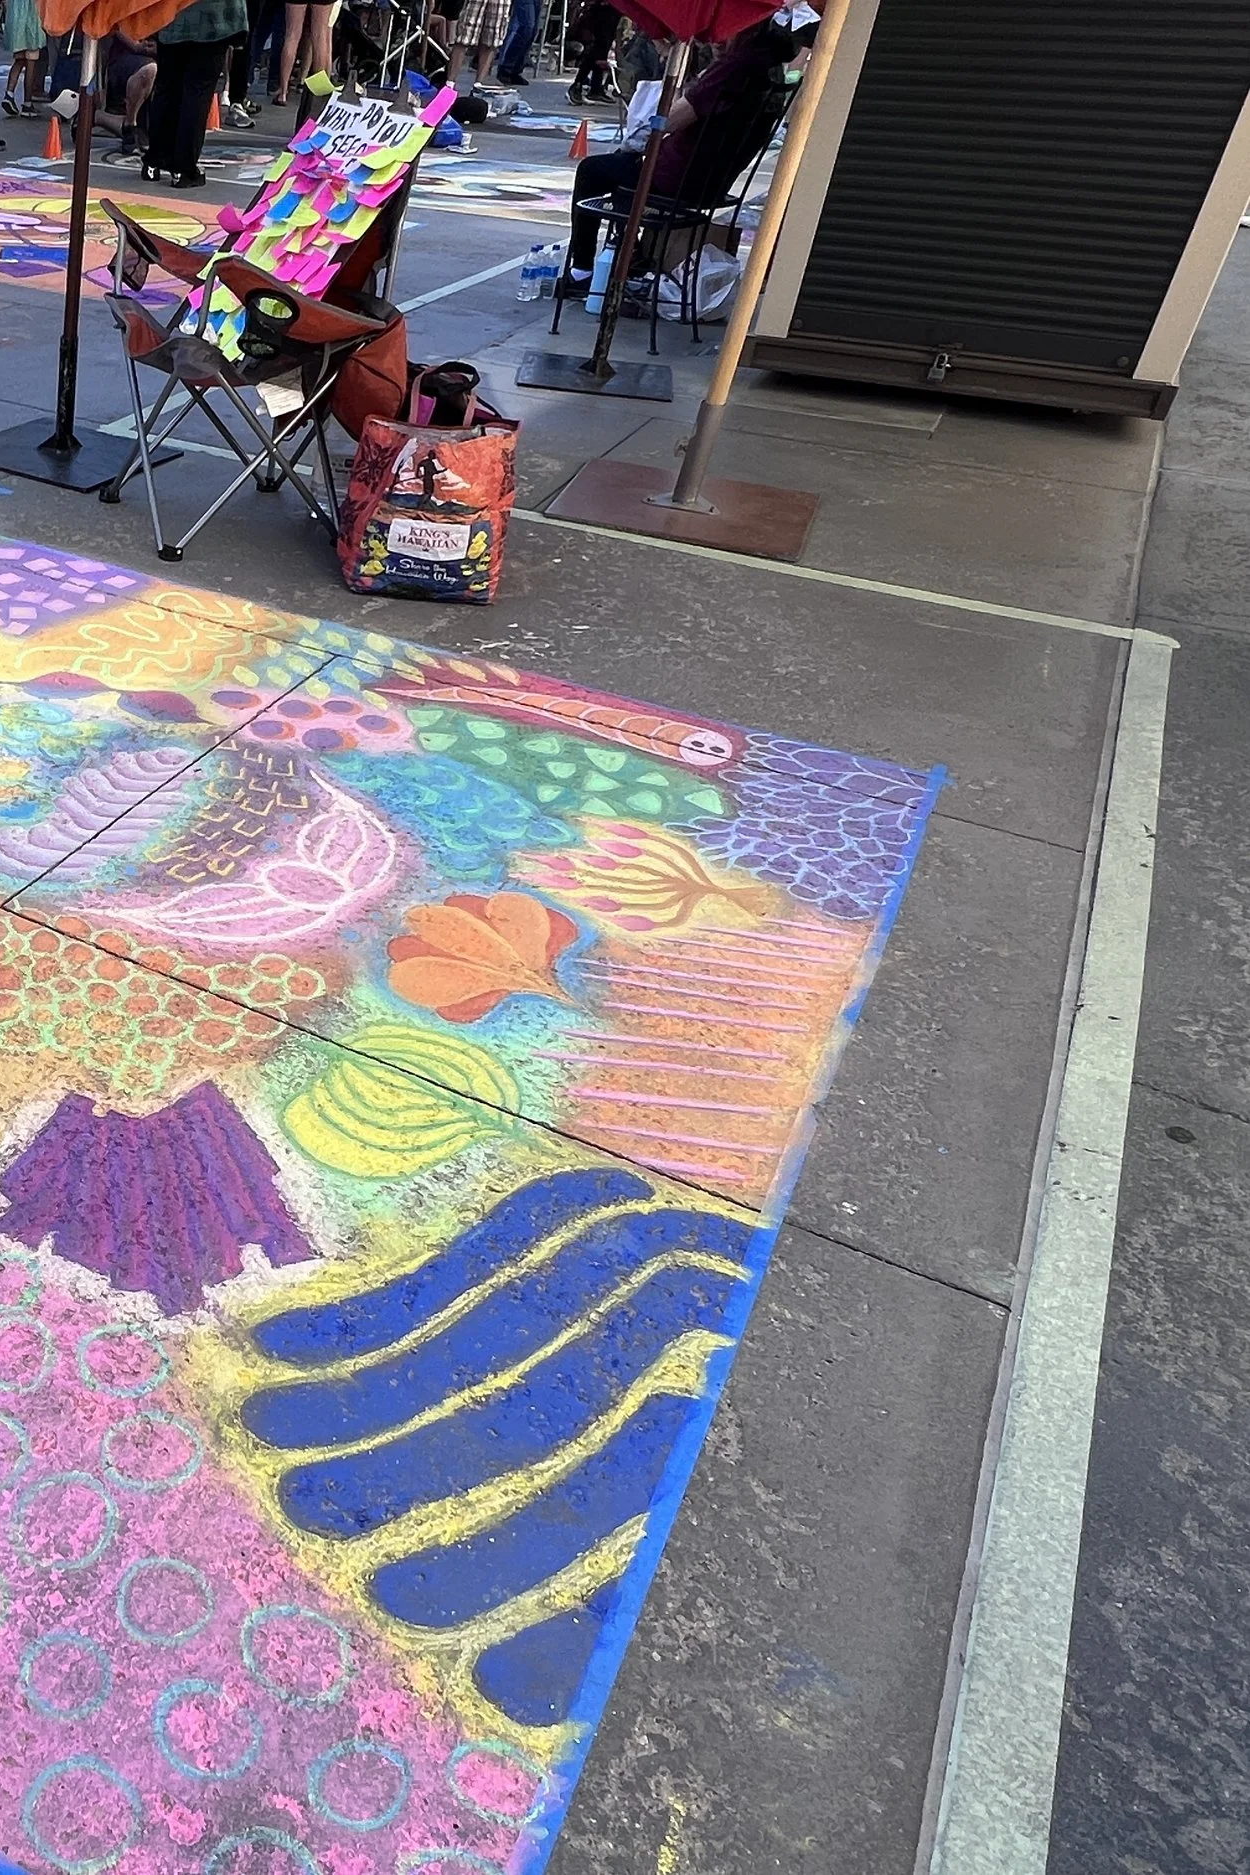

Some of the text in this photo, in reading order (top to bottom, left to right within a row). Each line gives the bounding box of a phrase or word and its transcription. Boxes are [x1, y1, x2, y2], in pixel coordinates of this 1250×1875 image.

[319, 103, 414, 148] WHAT DO YOU
[398, 533, 458, 548] HAWAIIAN
